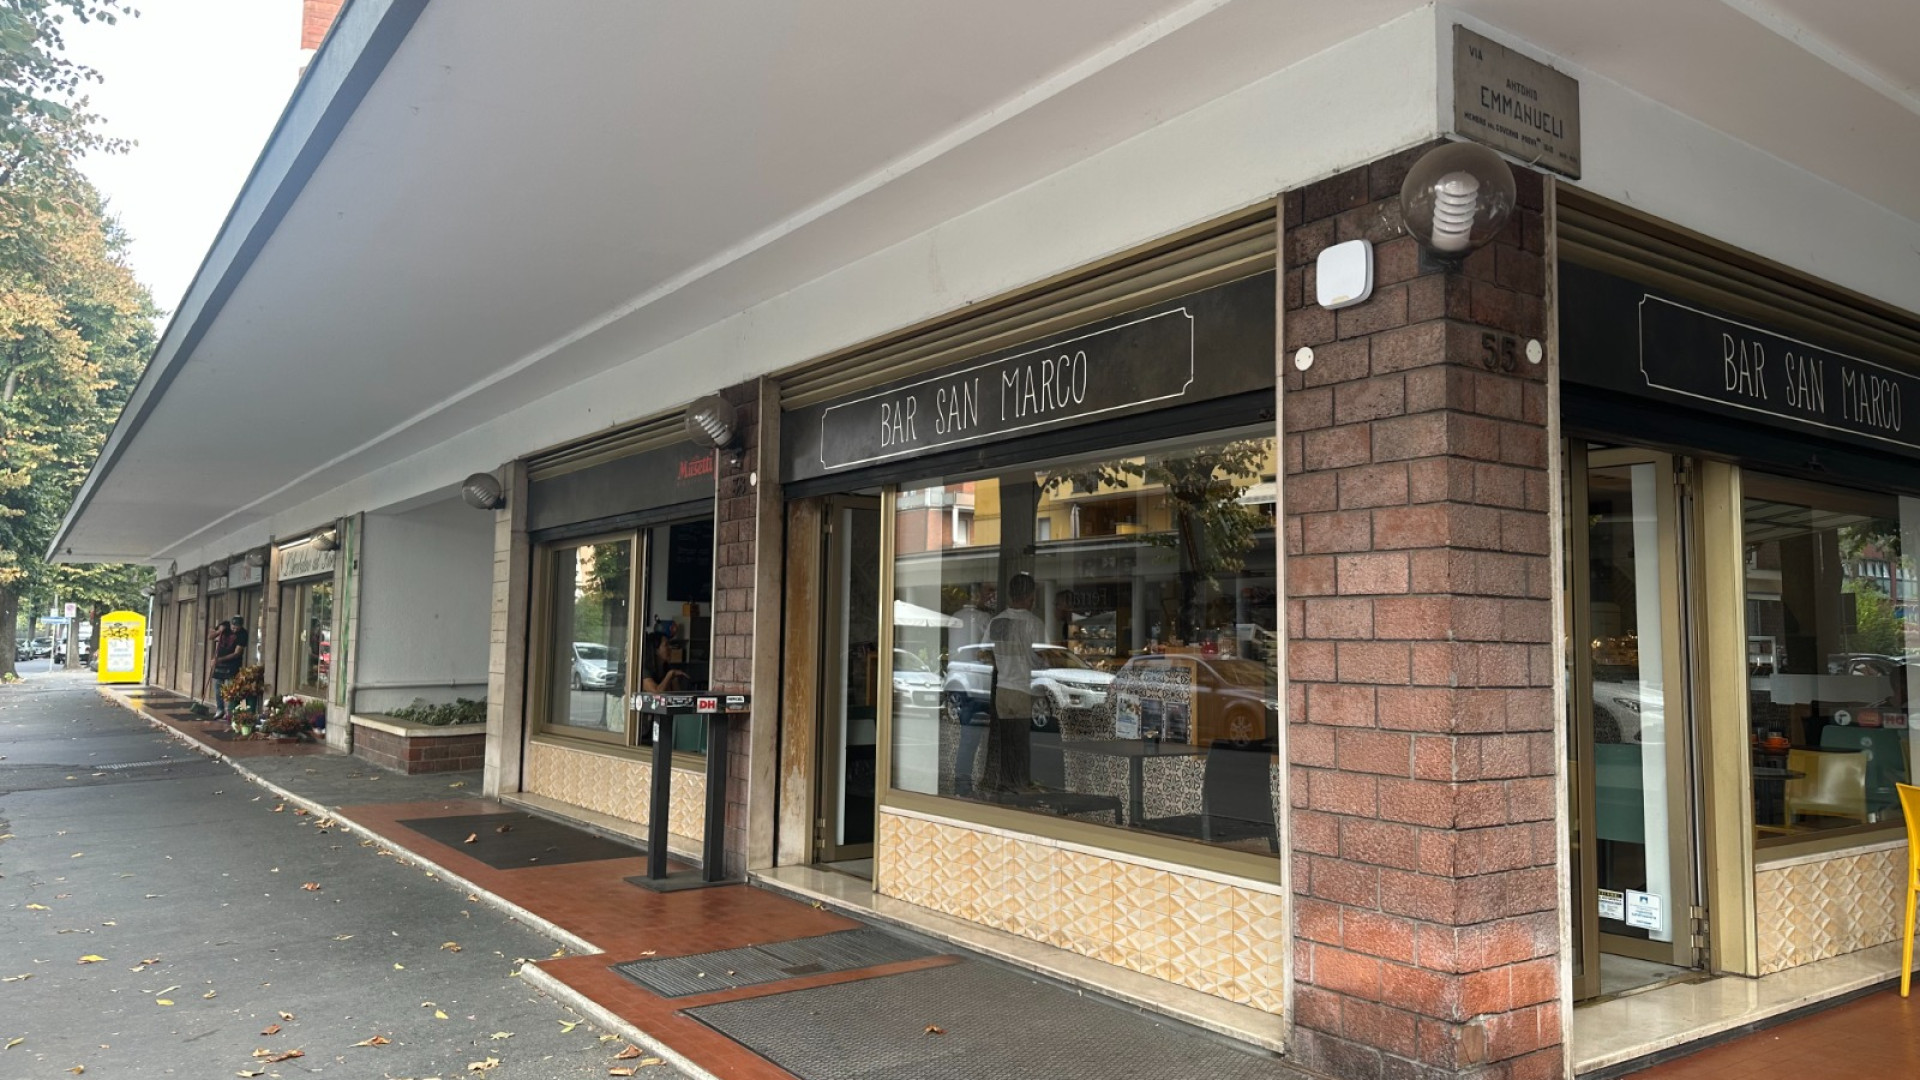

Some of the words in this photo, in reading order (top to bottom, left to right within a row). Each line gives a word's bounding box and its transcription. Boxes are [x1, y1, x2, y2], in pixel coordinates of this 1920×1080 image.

[1469, 45, 1483, 61] VIA
[1506, 78, 1538, 101] ANTONIO
[1481, 86, 1563, 139] EMMANUELI
[1481, 332, 1517, 373] 55
[881, 396, 917, 448] BAR
[936, 378, 979, 435] SAN
[1001, 351, 1087, 421] MARCO
[1723, 333, 1767, 400] BAR
[1785, 352, 1824, 414] SAN
[1842, 366, 1901, 432] MARCO
[699, 700, 716, 710] DH
